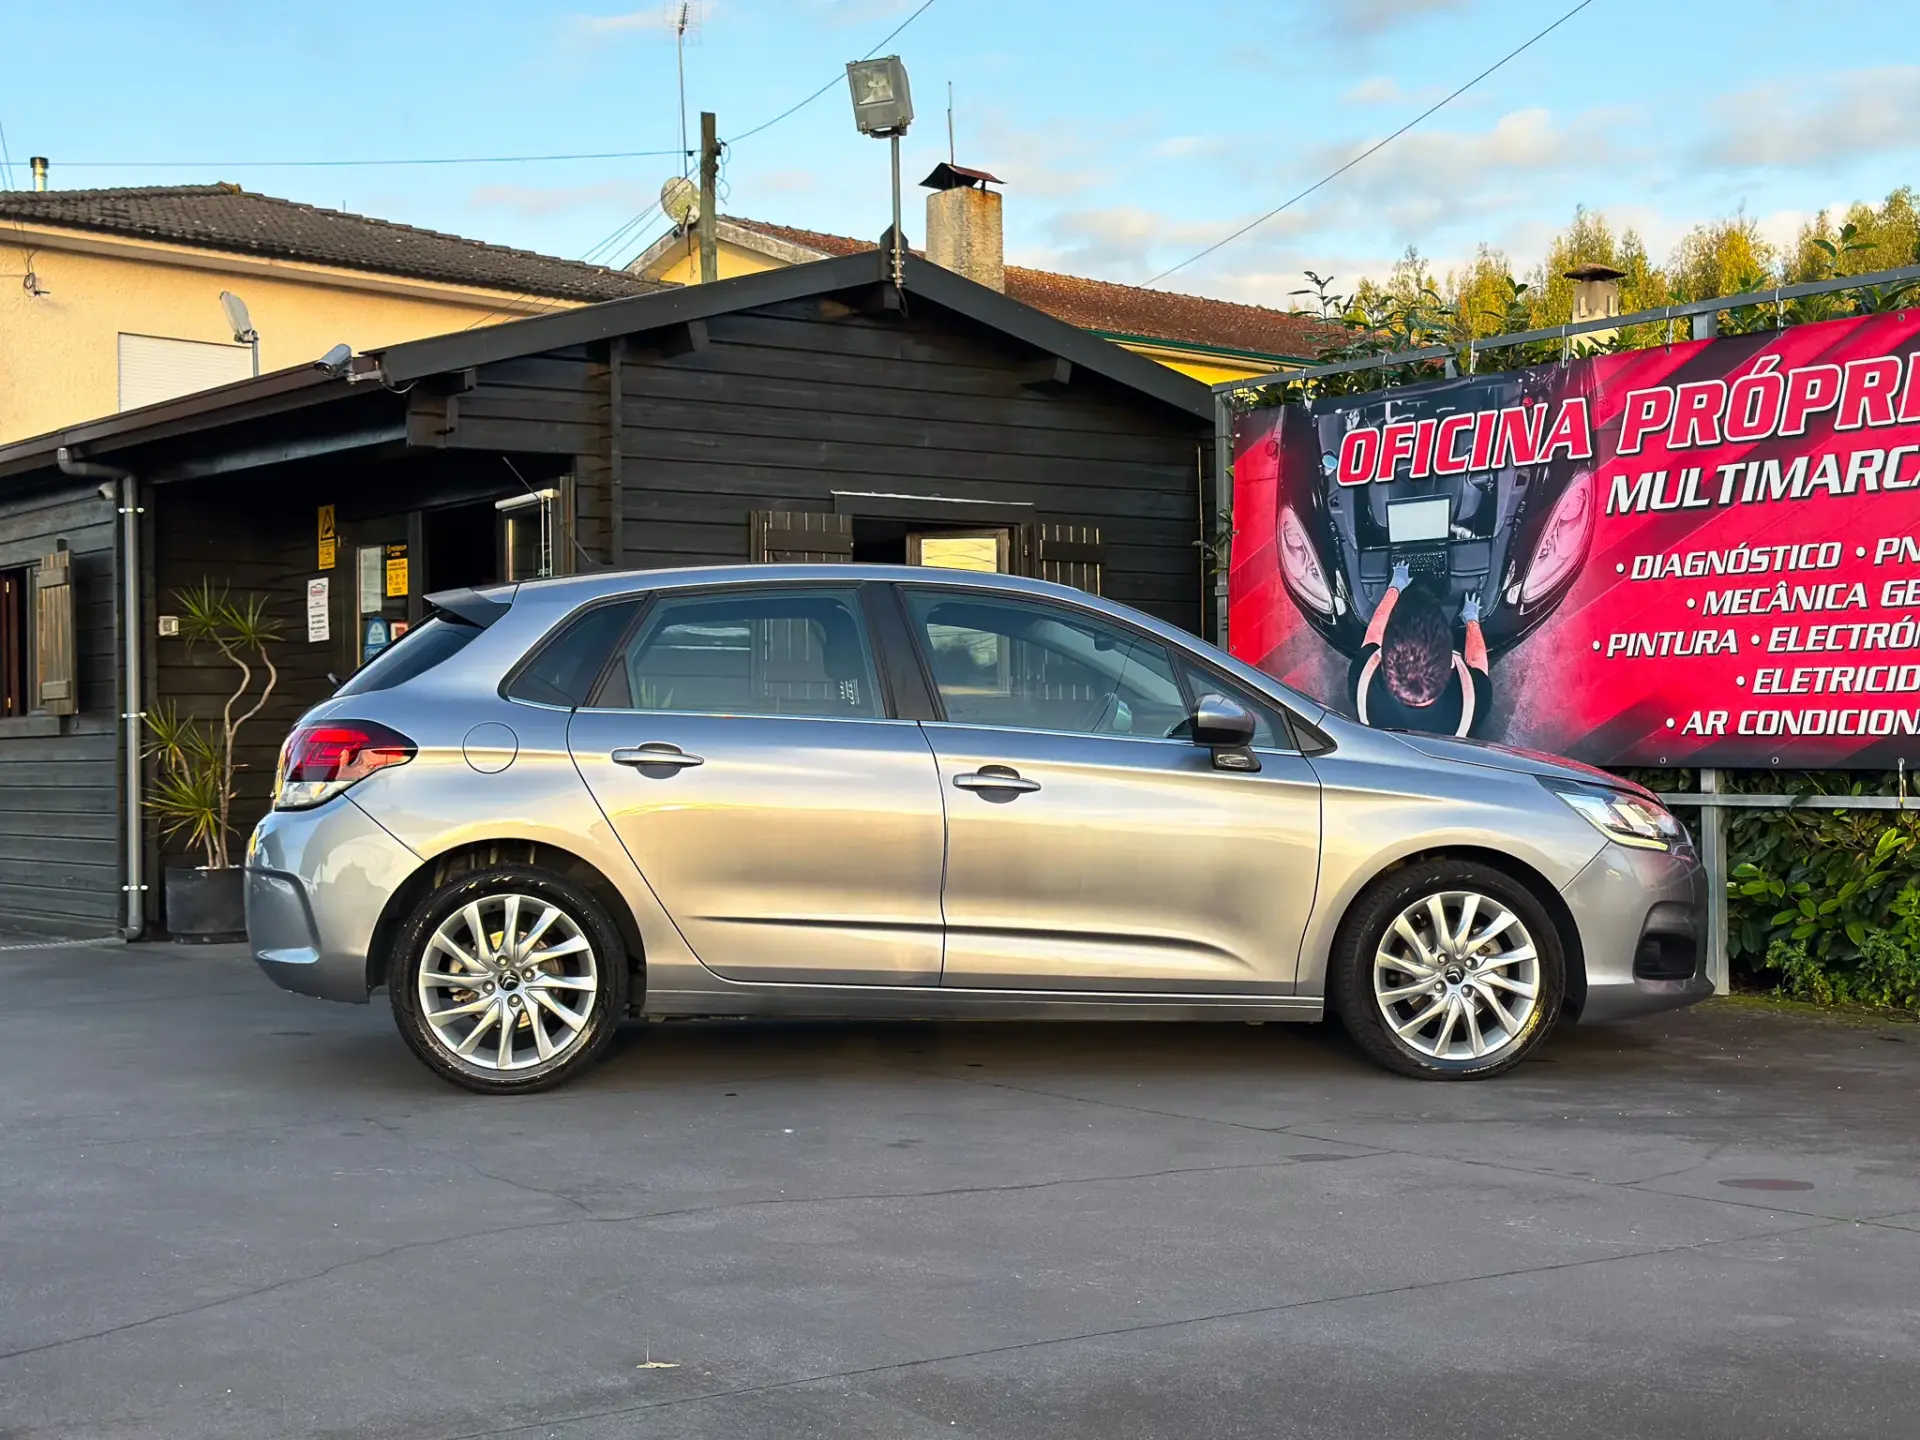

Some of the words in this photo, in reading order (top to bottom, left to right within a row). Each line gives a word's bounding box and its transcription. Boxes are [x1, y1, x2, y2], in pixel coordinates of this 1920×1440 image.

[1336, 397, 1593, 487] OFICINA
[1605, 444, 1920, 515] MULTIMARC
[1630, 541, 1842, 580] DIAGNÓSTICO
[1873, 536, 1920, 565] PN
[1702, 580, 1868, 615] MECÂNICA
[1880, 579, 1920, 607] GE
[1606, 629, 1739, 658] PINTURA
[1767, 614, 1920, 652] ELECTRÓ
[1752, 665, 1920, 693] ELETRICID
[1681, 710, 1729, 735] AR
[1738, 709, 1920, 735] CONDICION
